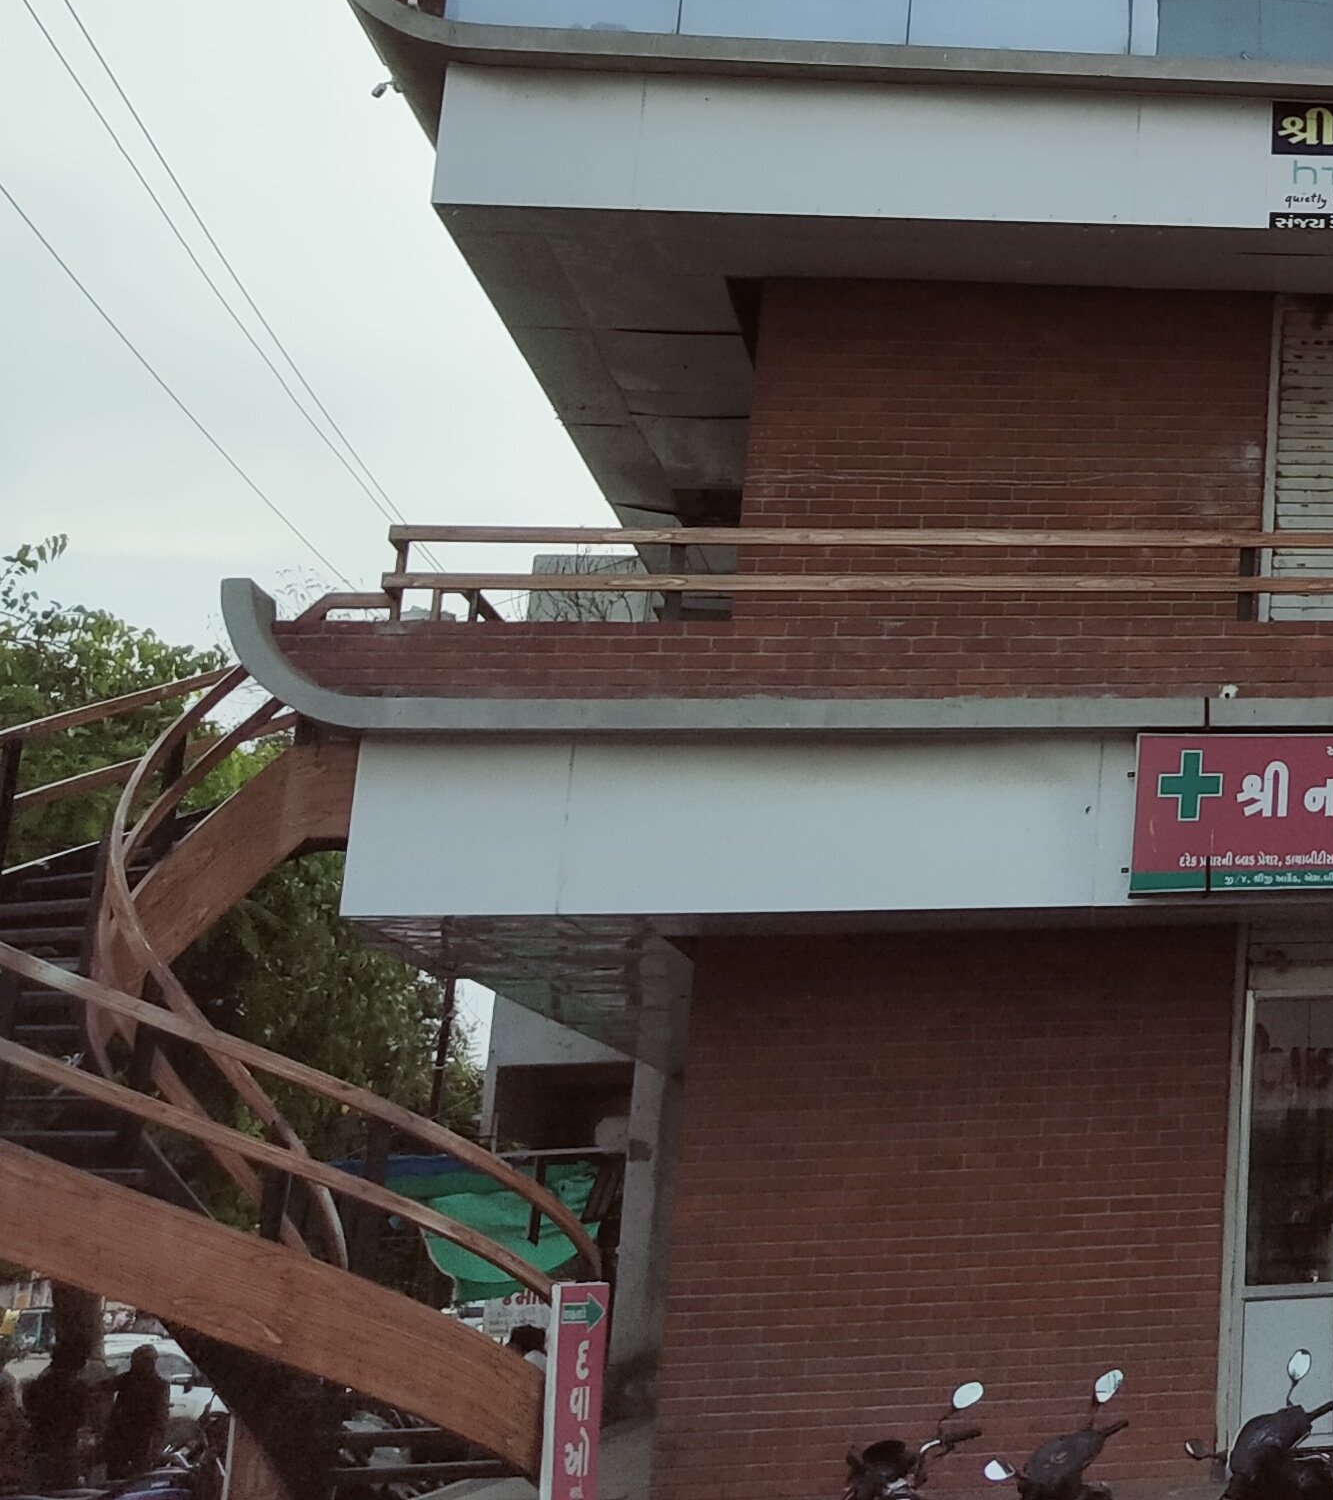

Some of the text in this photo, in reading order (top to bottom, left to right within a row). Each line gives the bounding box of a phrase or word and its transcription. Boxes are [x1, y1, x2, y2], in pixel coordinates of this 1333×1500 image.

[1285, 193, 1327, 209] quietly
[1275, 216, 1324, 230] સંજય
[1236, 760, 1289, 818] શ્રી
